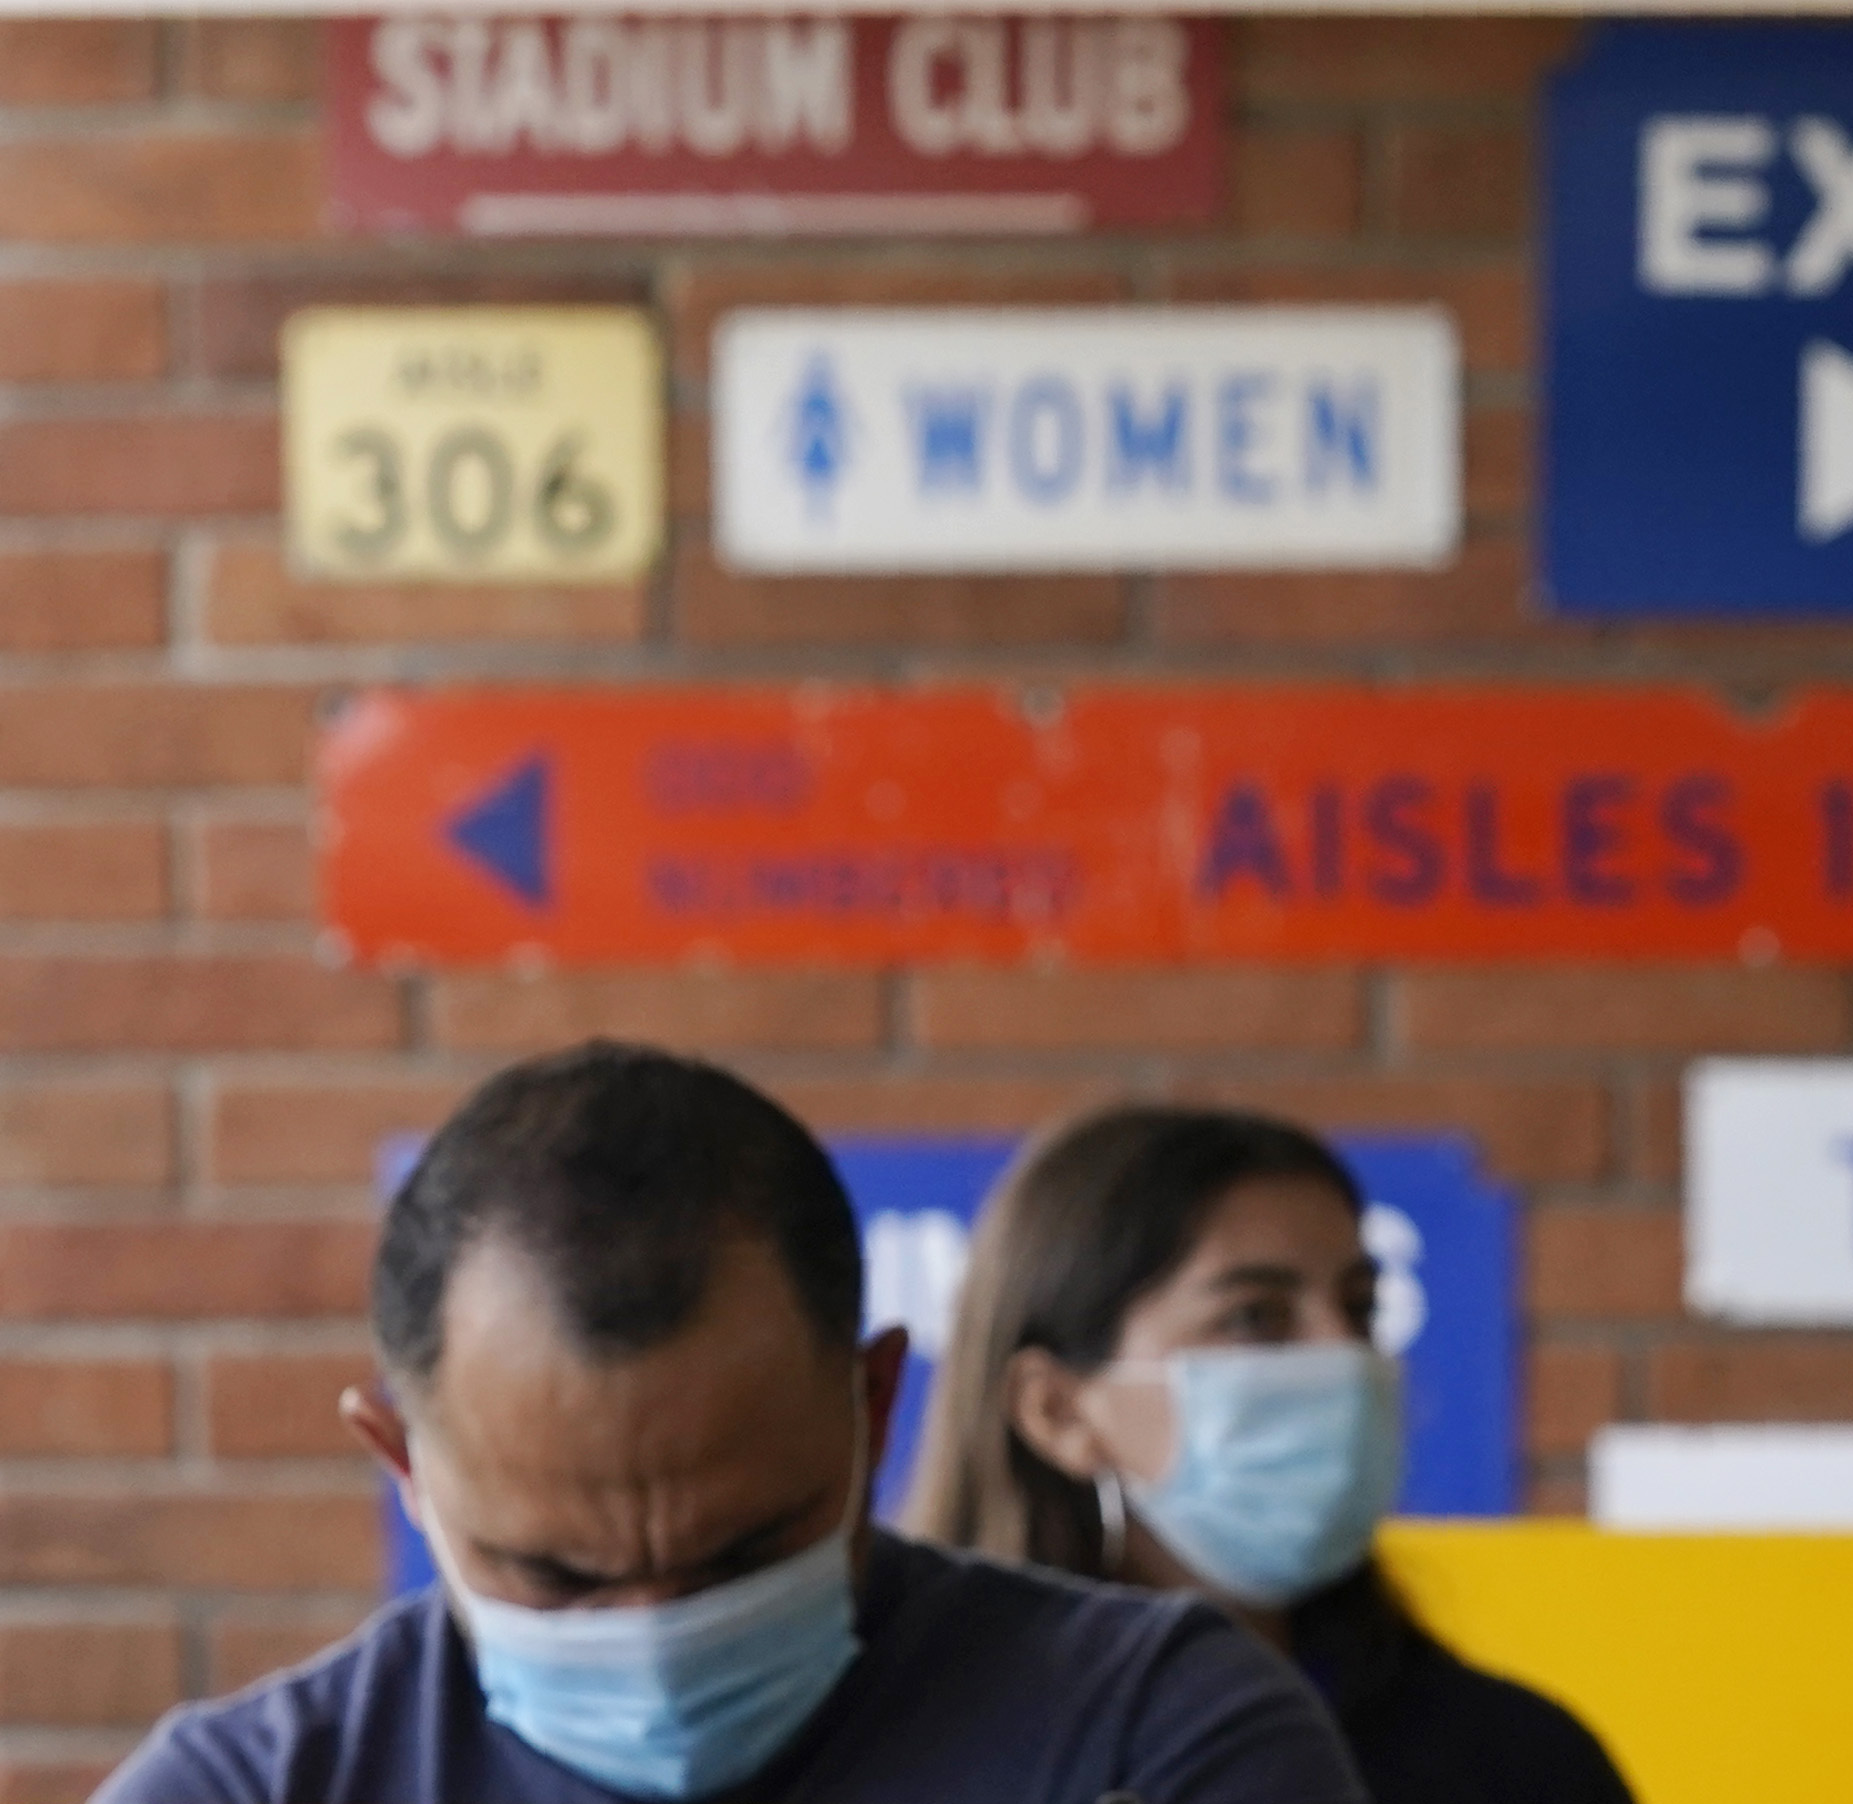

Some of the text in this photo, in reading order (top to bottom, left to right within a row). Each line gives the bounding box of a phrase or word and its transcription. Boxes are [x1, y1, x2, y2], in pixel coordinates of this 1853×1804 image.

[367, 15, 1190, 157] STADIUM CLUB
[331, 421, 616, 560] 306
[900, 366, 1382, 508] WOMEN
[1199, 772, 1745, 908] AISLES
